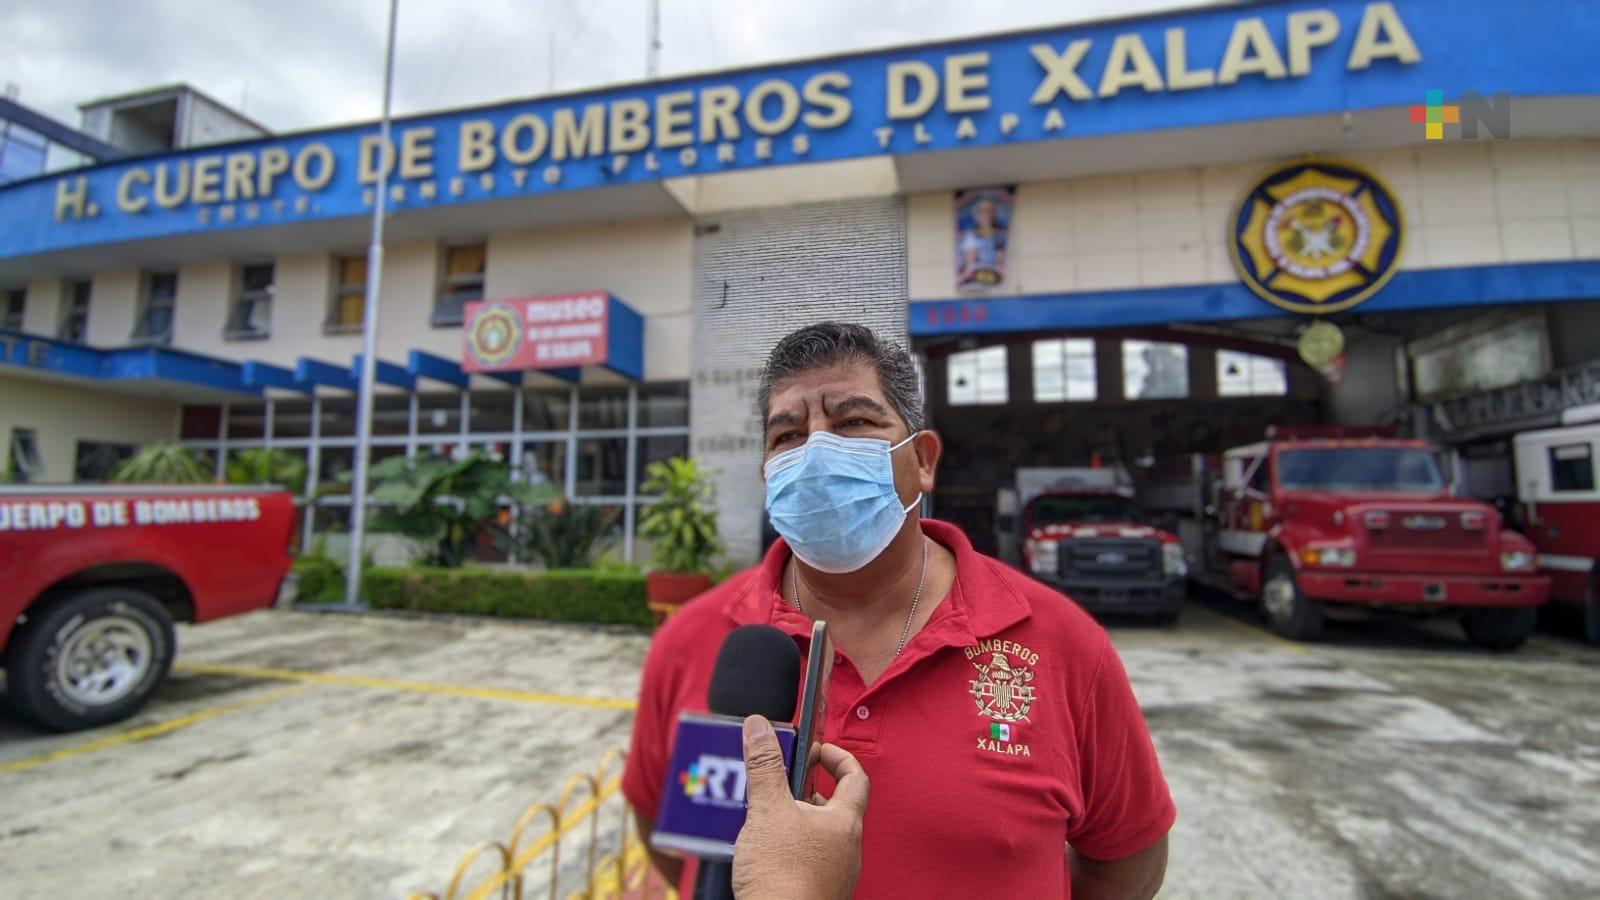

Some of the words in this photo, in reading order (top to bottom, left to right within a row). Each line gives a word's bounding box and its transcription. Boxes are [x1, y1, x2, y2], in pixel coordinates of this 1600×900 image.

[54, 176, 98, 222] H.
[117, 141, 337, 214] CUERPO
[357, 125, 436, 185] DE
[459, 71, 853, 172] BOMBEROS
[886, 52, 991, 120] DE
[1029, 2, 1423, 105] XALAPA
[612, 134, 810, 175] FLORES
[875, 108, 1066, 148] TLAPA
[92, 502, 129, 527] DE
[134, 497, 261, 525] BOMBEROS
[963, 639, 1039, 666] BOMBEROS
[977, 738, 1031, 757] XALAPA
